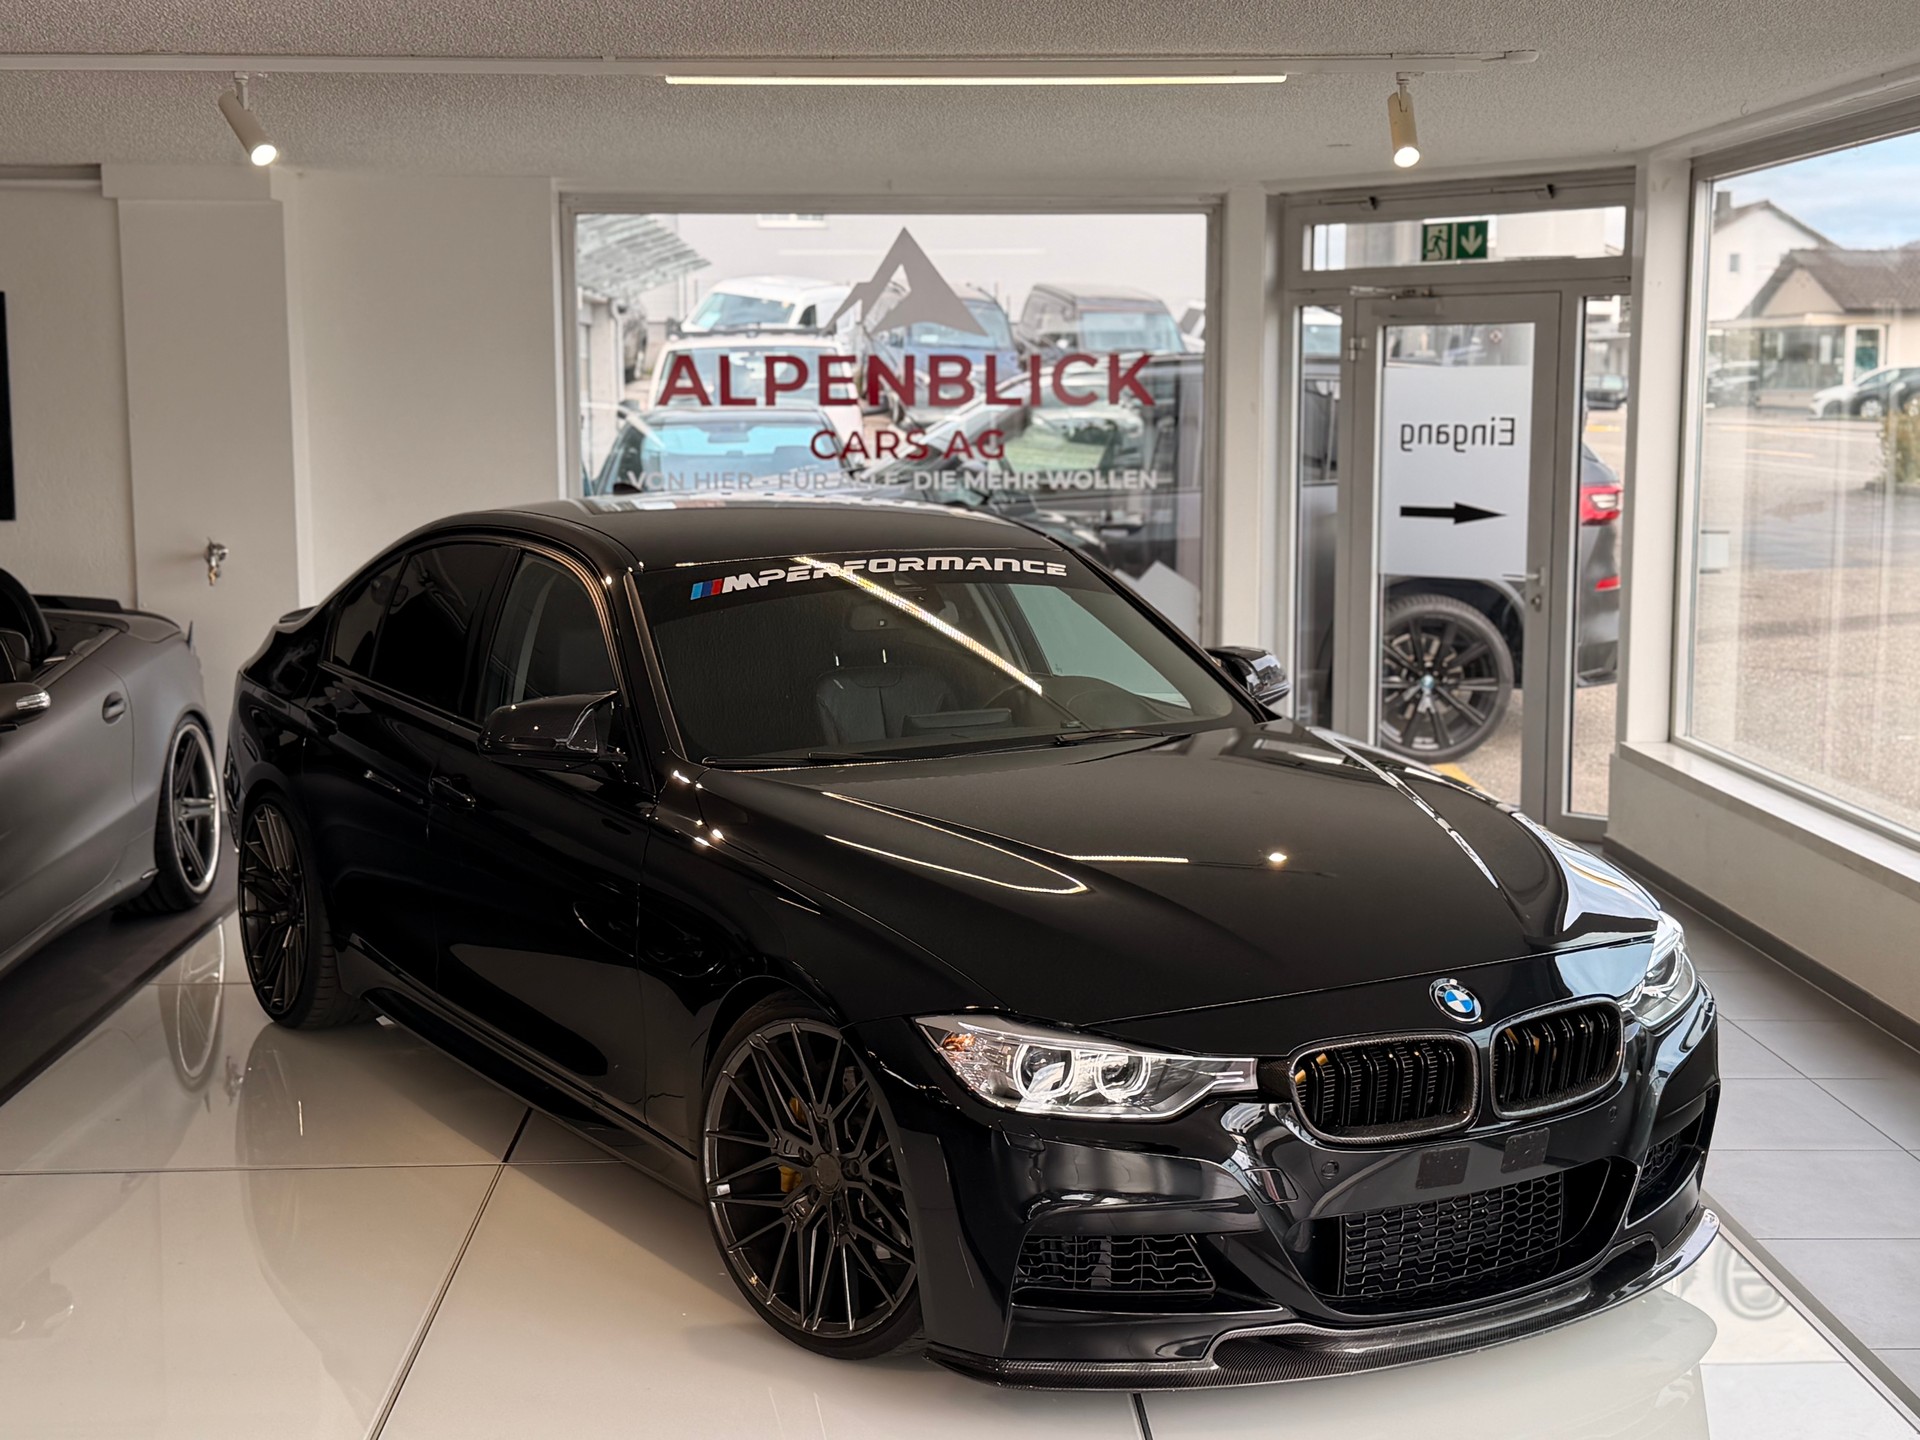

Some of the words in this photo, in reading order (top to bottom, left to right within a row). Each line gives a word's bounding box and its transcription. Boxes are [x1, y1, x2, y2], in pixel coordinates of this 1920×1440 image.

[658, 353, 1156, 407] ALPENBLICK
[810, 429, 929, 460] CARS
[943, 429, 1006, 460] AG
[627, 471, 685, 490] VON
[694, 471, 753, 490] HIER
[779, 465, 829, 490] FÜR
[913, 470, 957, 491] DIE
[963, 470, 1040, 491] MEHR
[1047, 470, 1158, 491] WOLLEN
